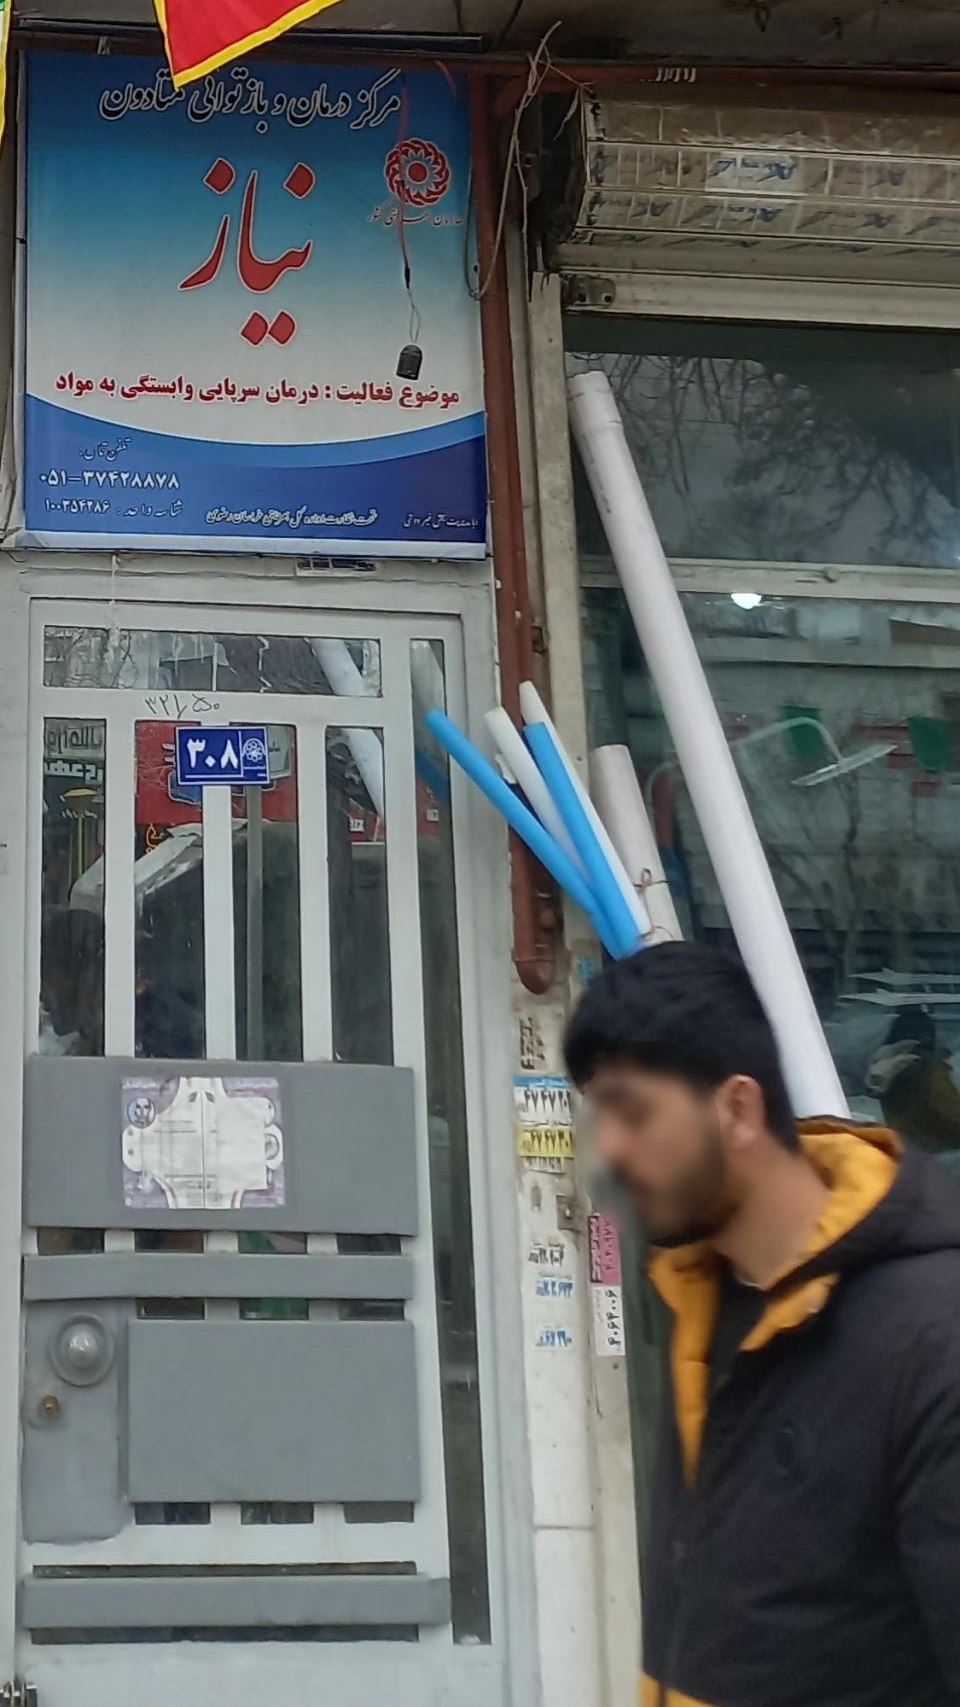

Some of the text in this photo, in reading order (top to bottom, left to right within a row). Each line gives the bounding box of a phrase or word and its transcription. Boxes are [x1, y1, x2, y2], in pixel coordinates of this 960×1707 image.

[271, 93, 287, 116] و
[288, 83, 351, 127] درمان
[350, 68, 403, 130] مرکز
[178, 157, 317, 347] نیاز
[55, 372, 95, 397] مواد
[98, 376, 116, 398] به
[120, 375, 194, 402] وابستگی
[198, 377, 261, 406] سرپایی
[265, 378, 320, 406] درمان
[335, 380, 394, 404] فعالیت
[398, 382, 460, 409] موضوع
[186, 737, 240, 770] ۳۰۸
